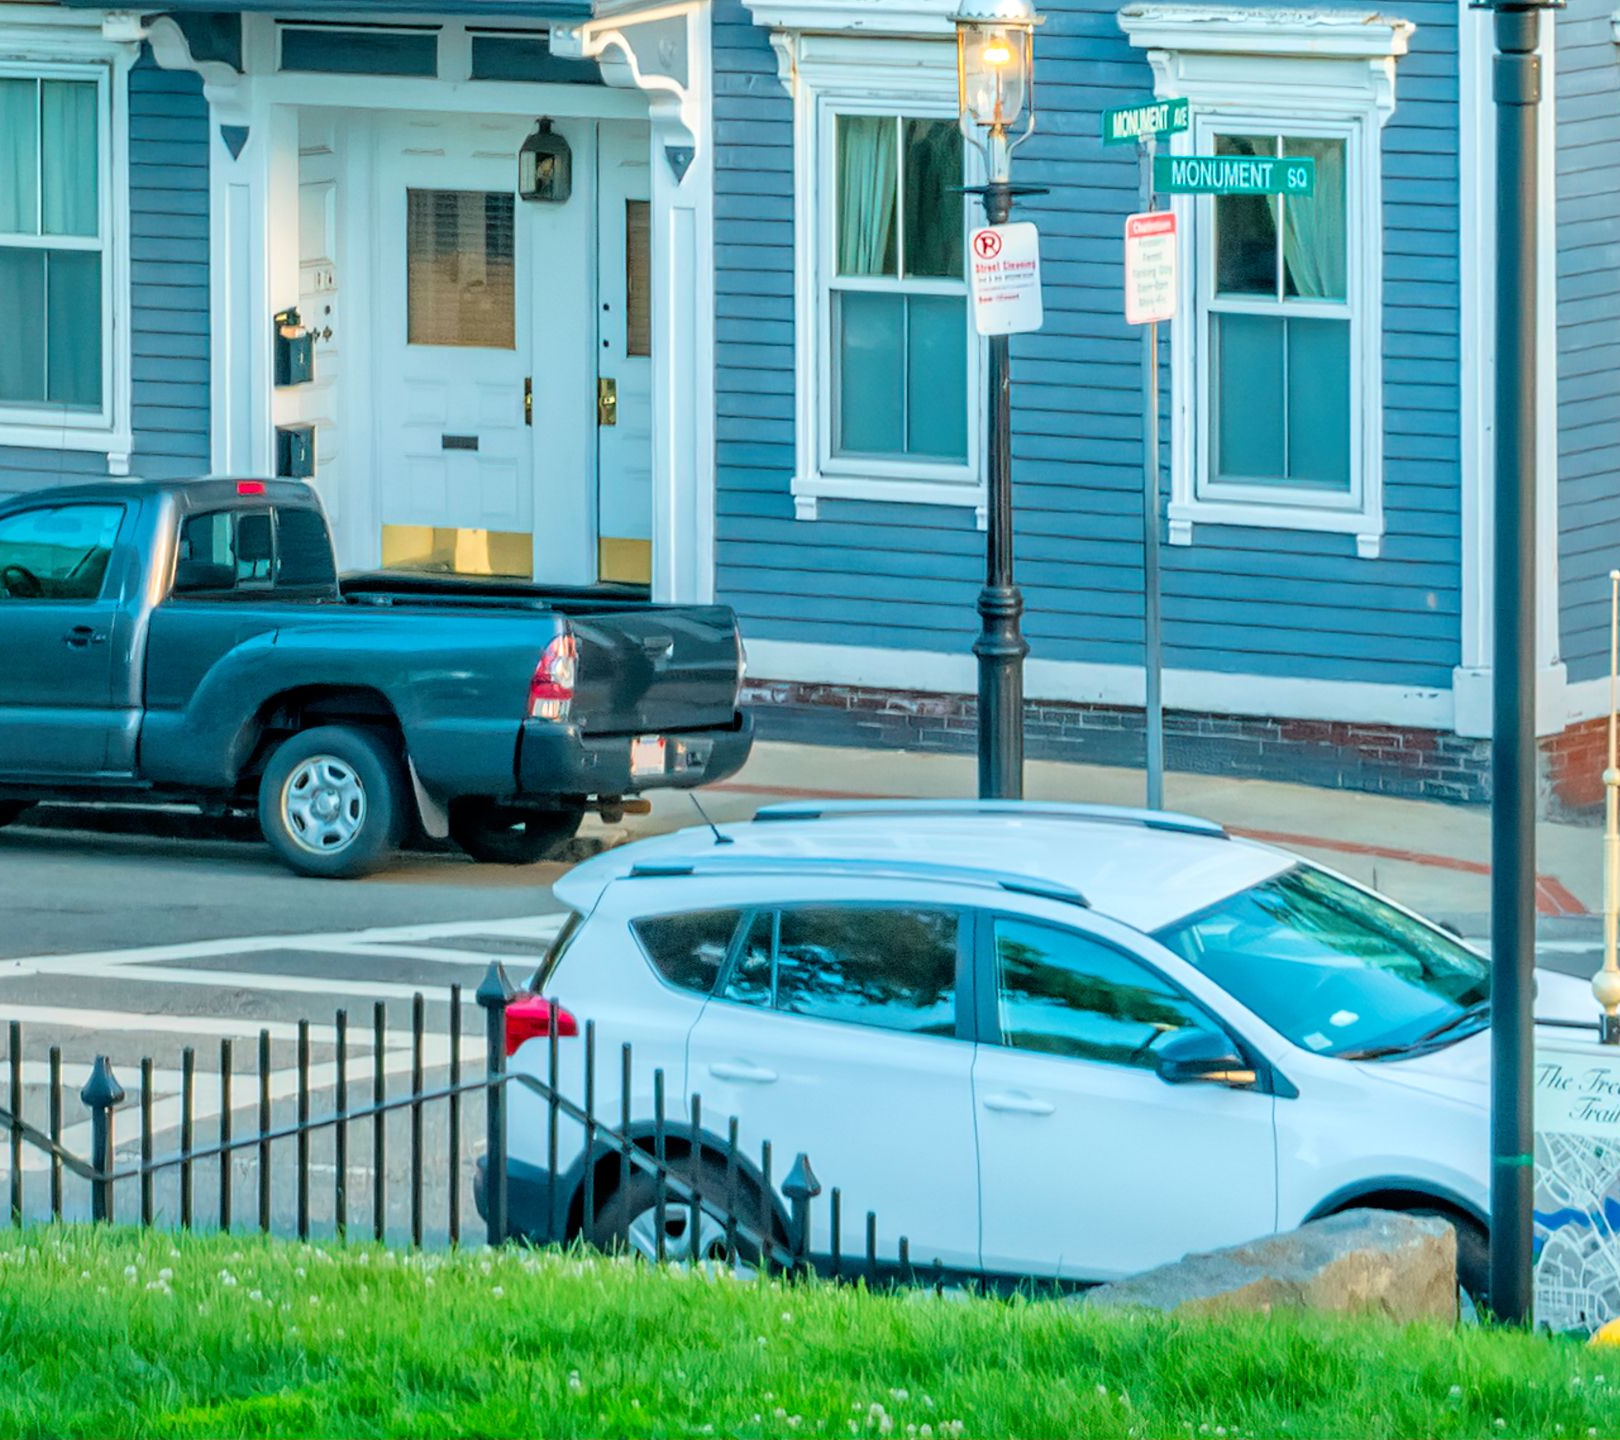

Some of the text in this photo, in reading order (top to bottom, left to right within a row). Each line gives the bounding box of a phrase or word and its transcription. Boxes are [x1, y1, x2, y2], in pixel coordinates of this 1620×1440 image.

[1112, 104, 1188, 139] MONUMENT AVE
[1172, 160, 1307, 188] MONUMENT SQ
[1537, 1063, 1574, 1090] The
